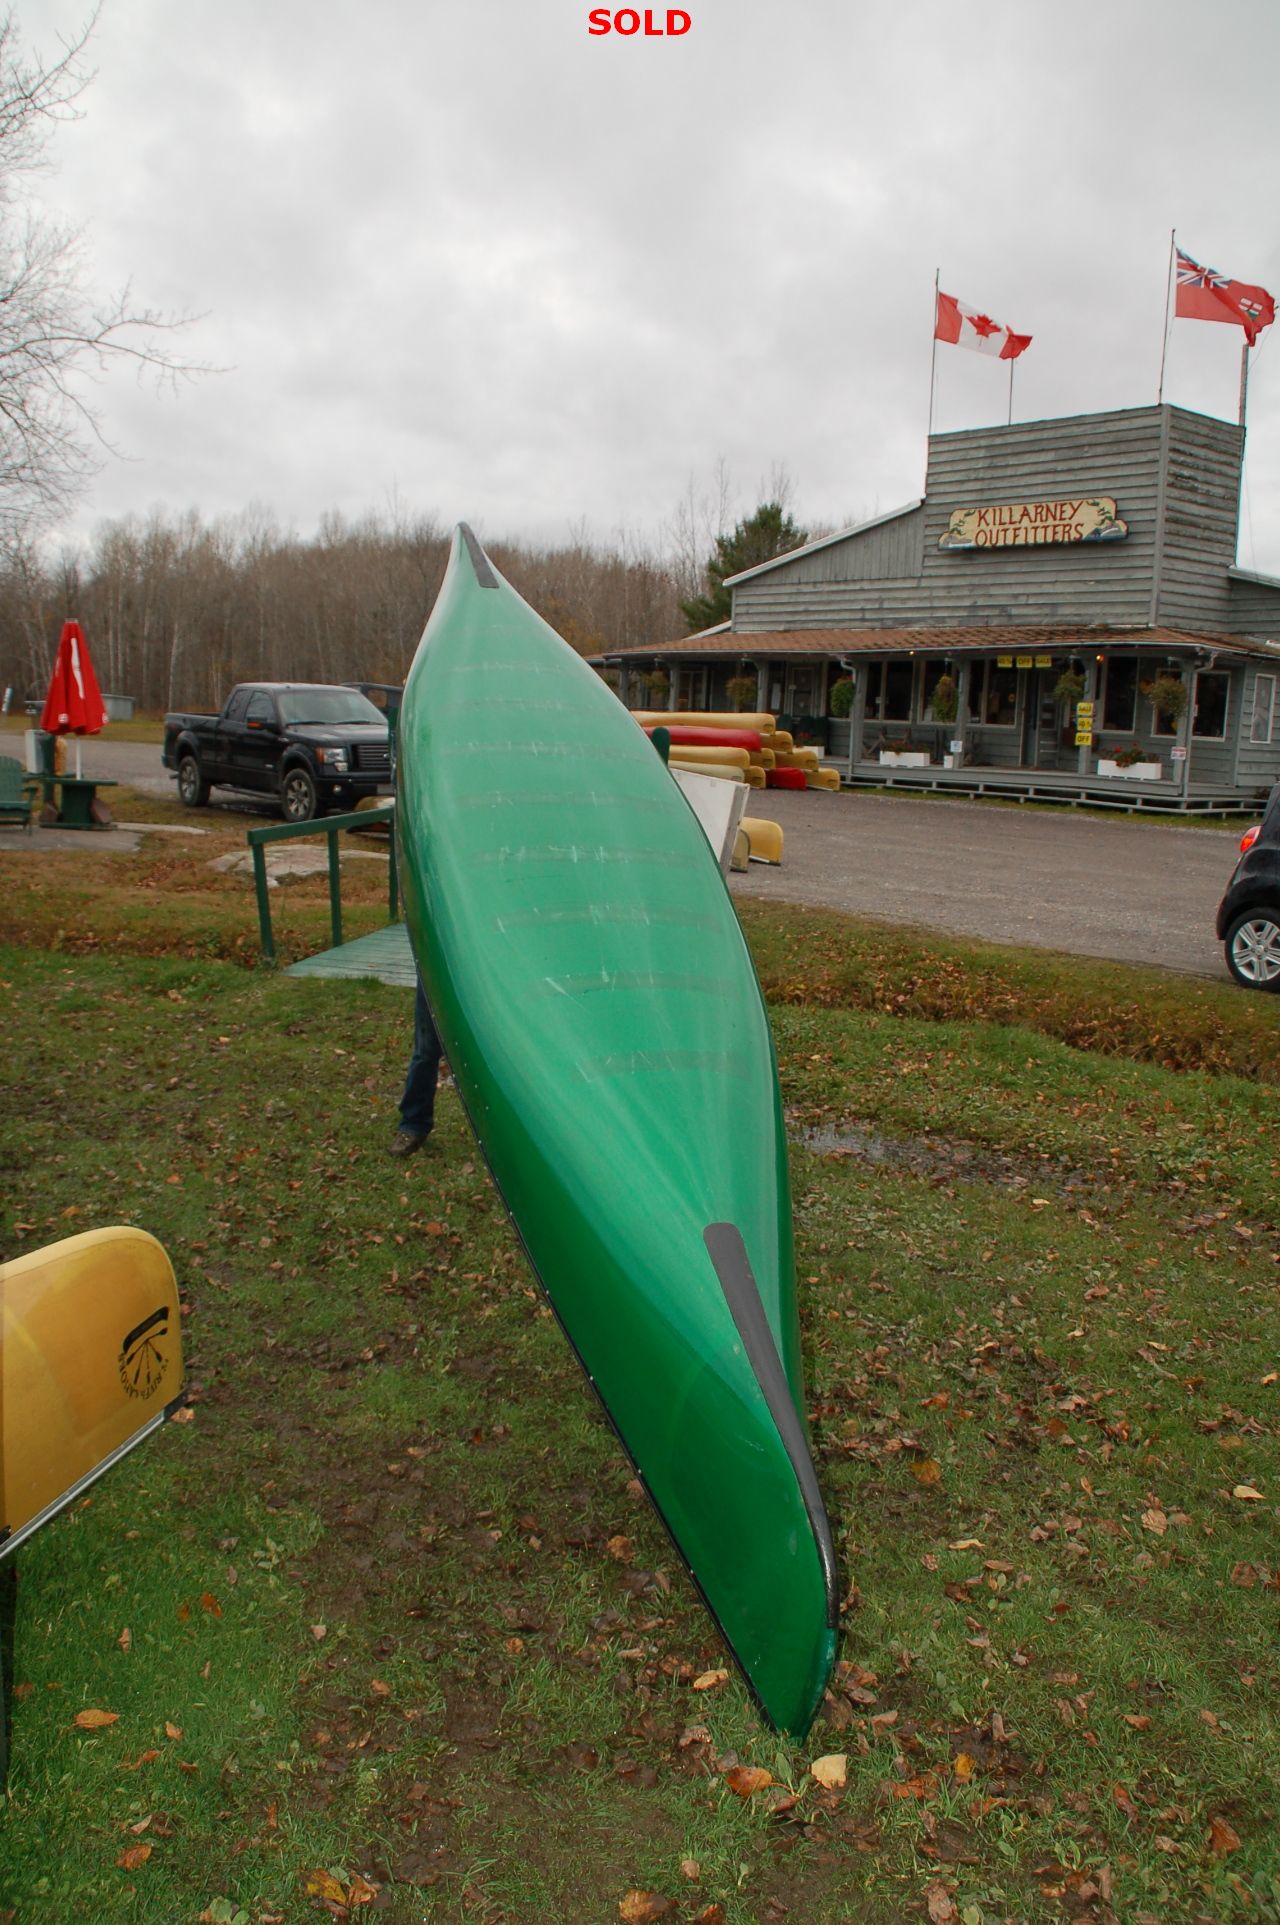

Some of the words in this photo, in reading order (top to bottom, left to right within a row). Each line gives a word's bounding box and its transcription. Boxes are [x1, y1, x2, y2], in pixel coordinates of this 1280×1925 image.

[977, 501, 1084, 527] KILLARNEY
[975, 523, 1085, 547] OUTFITTERS
[1018, 657, 1030, 665] OFF
[1077, 735, 1090, 743] OFF
